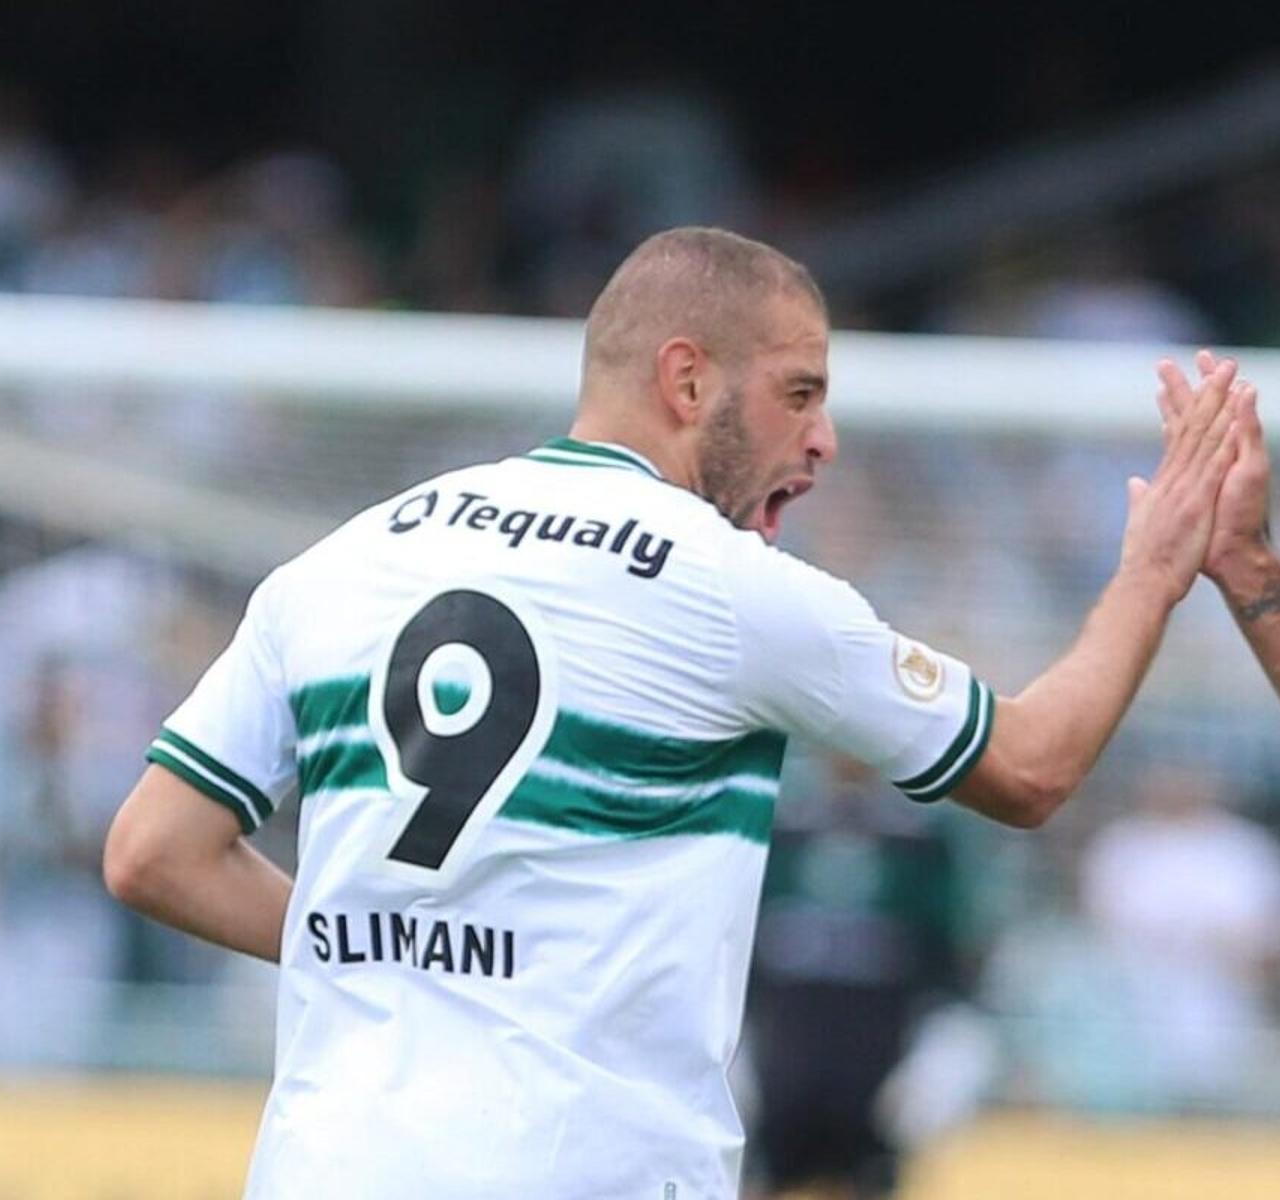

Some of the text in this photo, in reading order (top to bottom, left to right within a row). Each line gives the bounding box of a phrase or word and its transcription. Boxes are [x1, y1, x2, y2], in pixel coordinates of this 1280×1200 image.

[446, 491, 675, 580] Tequaly
[382, 588, 542, 872] 9
[307, 911, 514, 979] SLIMANI
